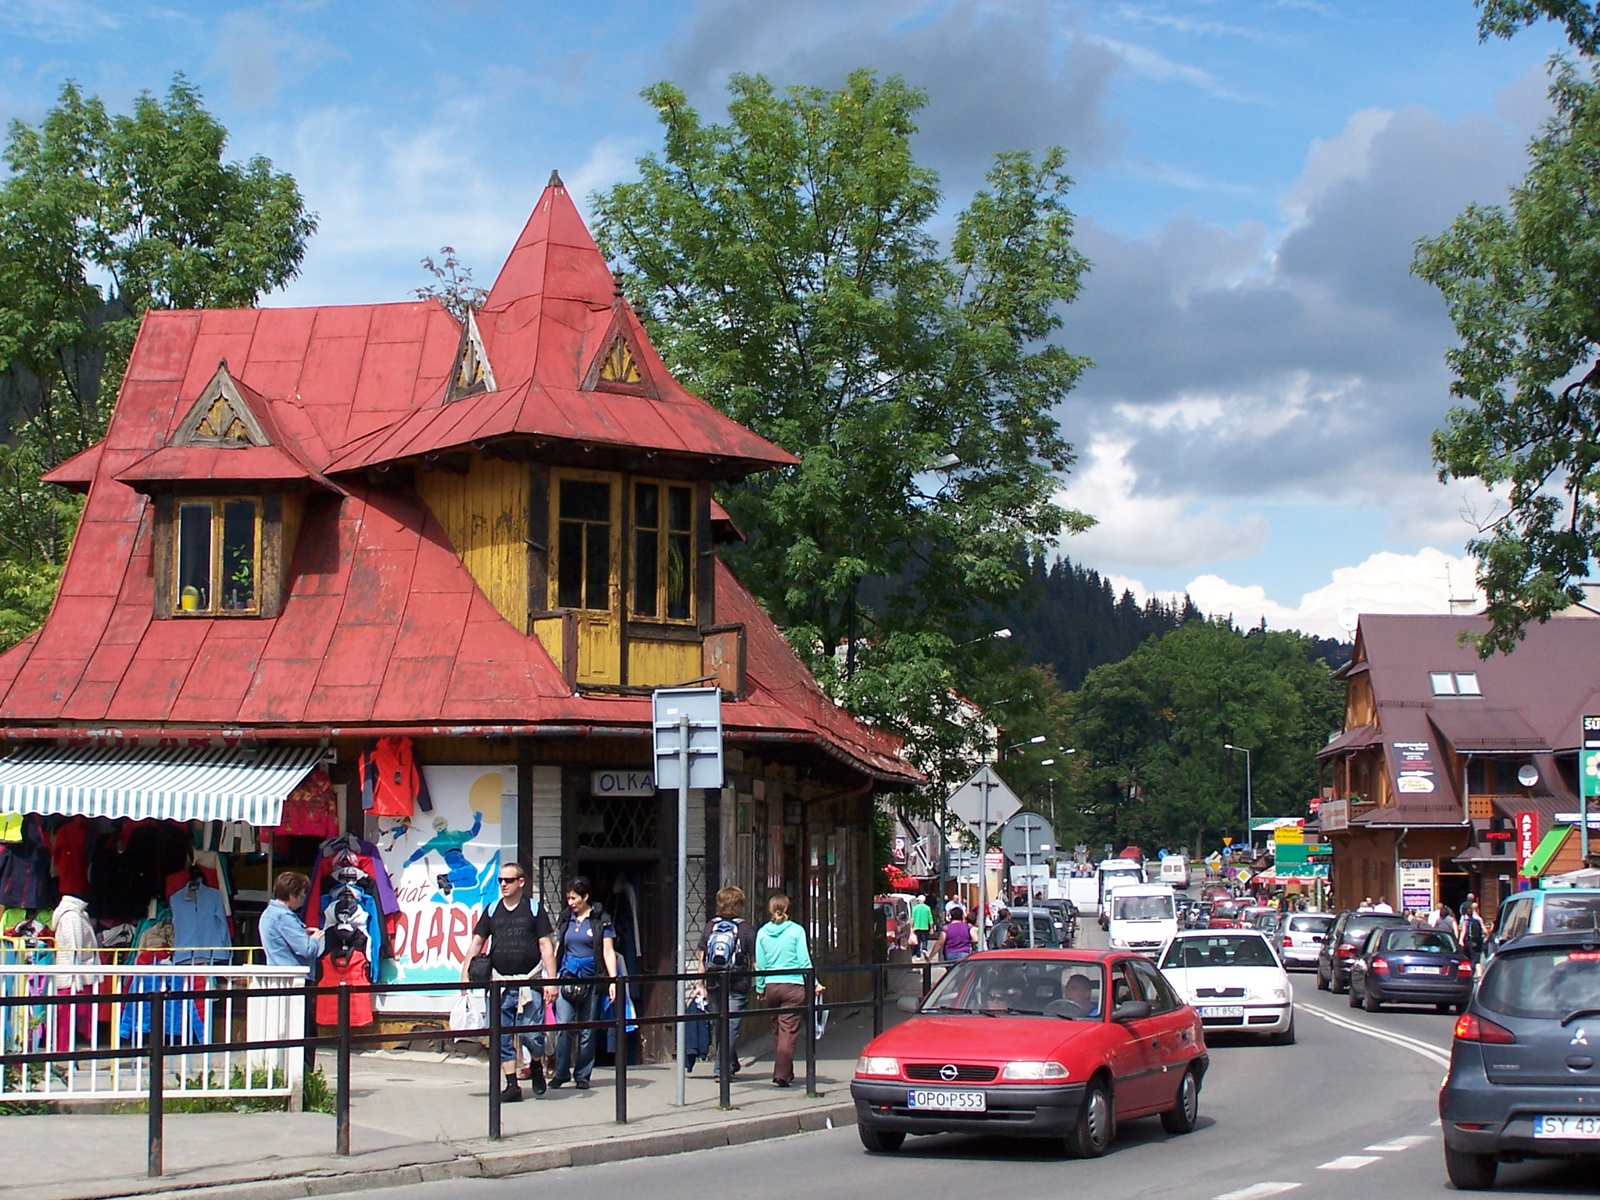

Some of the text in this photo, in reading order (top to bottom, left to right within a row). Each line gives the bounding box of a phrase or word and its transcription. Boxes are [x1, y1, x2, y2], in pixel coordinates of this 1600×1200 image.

[600, 772, 654, 792] OLKA
[950, 1094, 983, 1107] P553
[1545, 1117, 1568, 1133] SY
